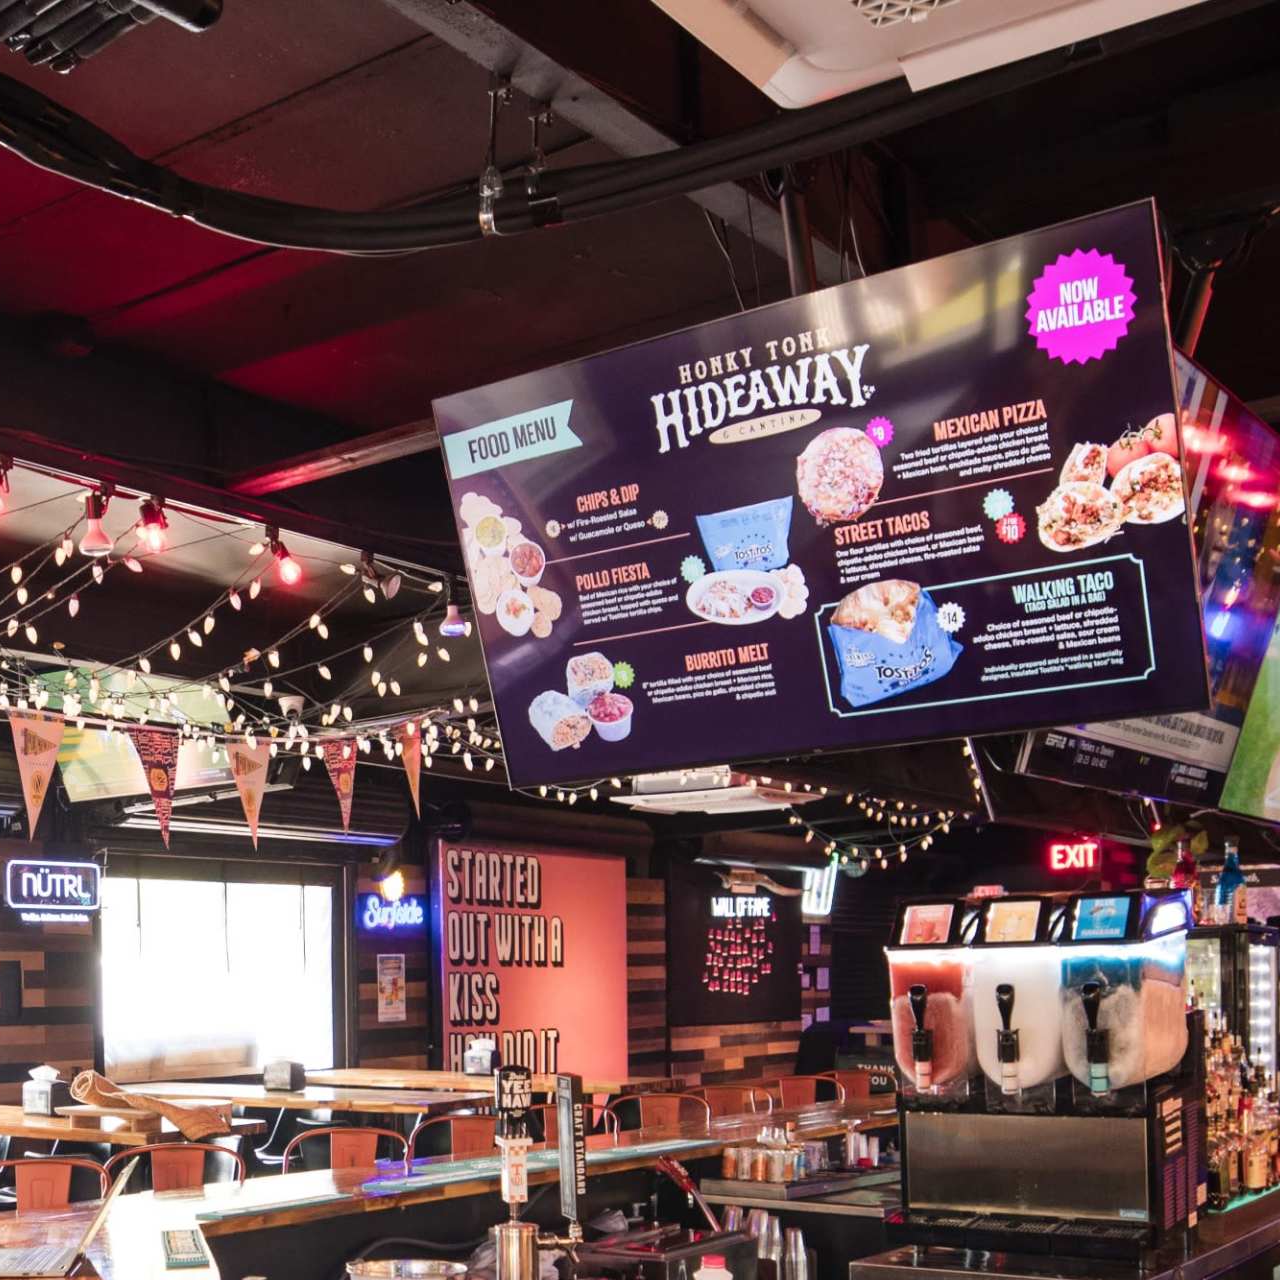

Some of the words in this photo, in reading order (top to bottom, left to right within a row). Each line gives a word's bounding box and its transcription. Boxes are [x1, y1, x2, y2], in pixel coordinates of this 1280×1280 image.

[1059, 276, 1097, 305] NOW
[1036, 295, 1124, 332] AVAILABLE
[678, 346, 751, 384] HONKY
[766, 324, 831, 360] TONK
[650, 343, 875, 453] HIDEAWAY
[739, 413, 805, 434] CANTINA
[932, 408, 1000, 441] MEXICAN
[1002, 398, 1047, 426] PIZZA
[467, 431, 510, 463] FOOD
[511, 415, 556, 449] MENU
[892, 458, 923, 471] seasoned
[923, 454, 939, 465] beef
[939, 454, 947, 462] or
[946, 443, 998, 460] chipotle-adobo
[998, 438, 1025, 449] chicken
[1025, 432, 1048, 444] breast
[899, 452, 914, 460] Two
[913, 447, 930, 457] fried
[930, 443, 957, 454] tortillas
[956, 436, 983, 448] layered
[982, 433, 998, 443] with
[998, 430, 1015, 441] your
[1015, 425, 1039, 436] choice
[1038, 422, 1047, 431] of
[901, 468, 929, 479] Mexican
[1004, 449, 1020, 459] pico
[1019, 446, 1030, 454] de
[958, 466, 972, 476] and
[992, 456, 1025, 470] shredded
[1025, 452, 1051, 463] cheese
[576, 490, 608, 512] CHIPS
[609, 488, 621, 505] &
[619, 483, 639, 503] DIP
[575, 510, 617, 527] Fire-Roasted
[617, 508, 637, 518] Salsa
[577, 526, 614, 540] Guacamole
[614, 524, 622, 532] or
[622, 520, 645, 531] Queso
[834, 518, 882, 545] STREET
[884, 510, 930, 535] TACOS
[835, 550, 849, 558] One
[848, 547, 864, 555] flour
[864, 542, 889, 552] tortillas
[888, 538, 904, 548] with
[903, 536, 925, 545] choice
[924, 532, 933, 541] of
[933, 527, 965, 540] seasoned
[836, 552, 883, 567] chipotle-adobo
[882, 548, 908, 558] chicken
[930, 542, 938, 550] or
[937, 538, 967, 548] Mexican
[966, 534, 984, 543] bean
[868, 558, 898, 570] shredded
[923, 546, 962, 560] fire-roasted
[961, 544, 980, 553] salsa
[575, 569, 610, 591] POLLO
[610, 561, 650, 584] FIESTA
[845, 574, 860, 582] sour
[859, 571, 880, 580] cream
[1011, 576, 1075, 604] WALKING
[1076, 570, 1113, 594] TACO
[1024, 599, 1046, 613] (TACO
[1046, 596, 1070, 609] SALAD
[1070, 594, 1080, 606] IN
[1080, 593, 1086, 604] A
[1087, 590, 1105, 603] BAG)
[972, 633, 995, 643] adobo
[994, 630, 1023, 640] chicken
[1023, 625, 1047, 636] breast
[1082, 614, 1118, 627] shredded
[986, 622, 1011, 632] Choice
[1011, 619, 1020, 628] of
[1020, 614, 1056, 627] seasoned
[1055, 611, 1073, 621] beef
[1083, 606, 1117, 617] chipotle-
[1011, 632, 1055, 646] fire-roasted
[1077, 628, 1094, 637] sour
[1095, 625, 1120, 634] cream
[1065, 638, 1097, 648] Mexican
[1097, 634, 1121, 644] beans
[684, 648, 735, 671] BURRITO
[737, 642, 768, 663] MELT
[875, 648, 934, 680] TOSTITOS
[1050, 843, 1098, 870] EXIT
[447, 850, 541, 908] STARTED
[364, 895, 423, 929] Surfside
[712, 897, 735, 917] WALL
[736, 897, 748, 917] OF
[748, 897, 770, 917] FAME
[448, 912, 489, 966] OUT
[495, 914, 548, 967] WITH
[551, 916, 564, 967] A
[449, 972, 500, 1026] KISS
[502, 1080, 531, 1094] YEE
[870, 1076, 887, 1086] OU
[574, 1104, 584, 1138] CRAFT
[575, 1140, 586, 1195] STANDARD
